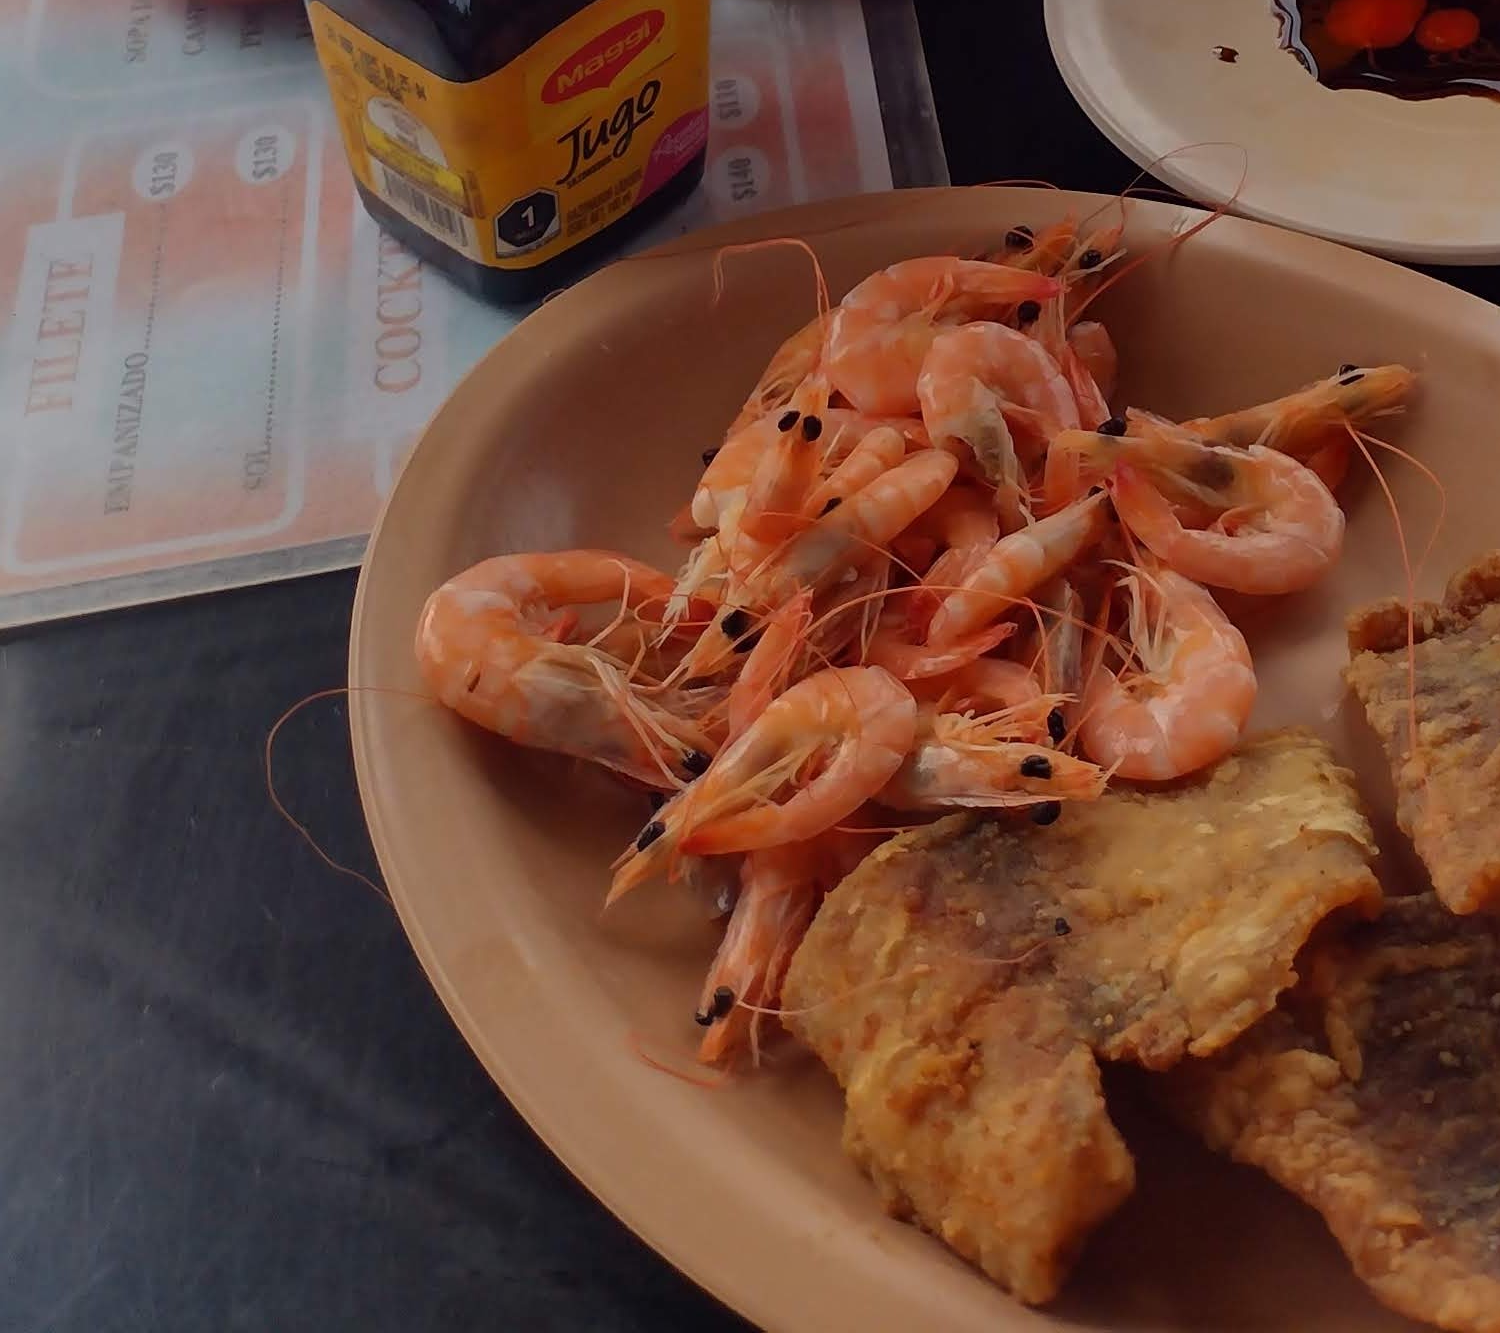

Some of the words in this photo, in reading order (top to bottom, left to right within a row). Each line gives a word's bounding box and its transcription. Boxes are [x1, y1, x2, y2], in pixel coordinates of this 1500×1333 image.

[251, 135, 280, 183] $130
[556, 79, 662, 186] Jugo
[521, 205, 536, 227] 1
[24, 251, 95, 417] FILETE
[105, 351, 149, 517] EMPANIZADO
[148, 150, 180, 197] $130
